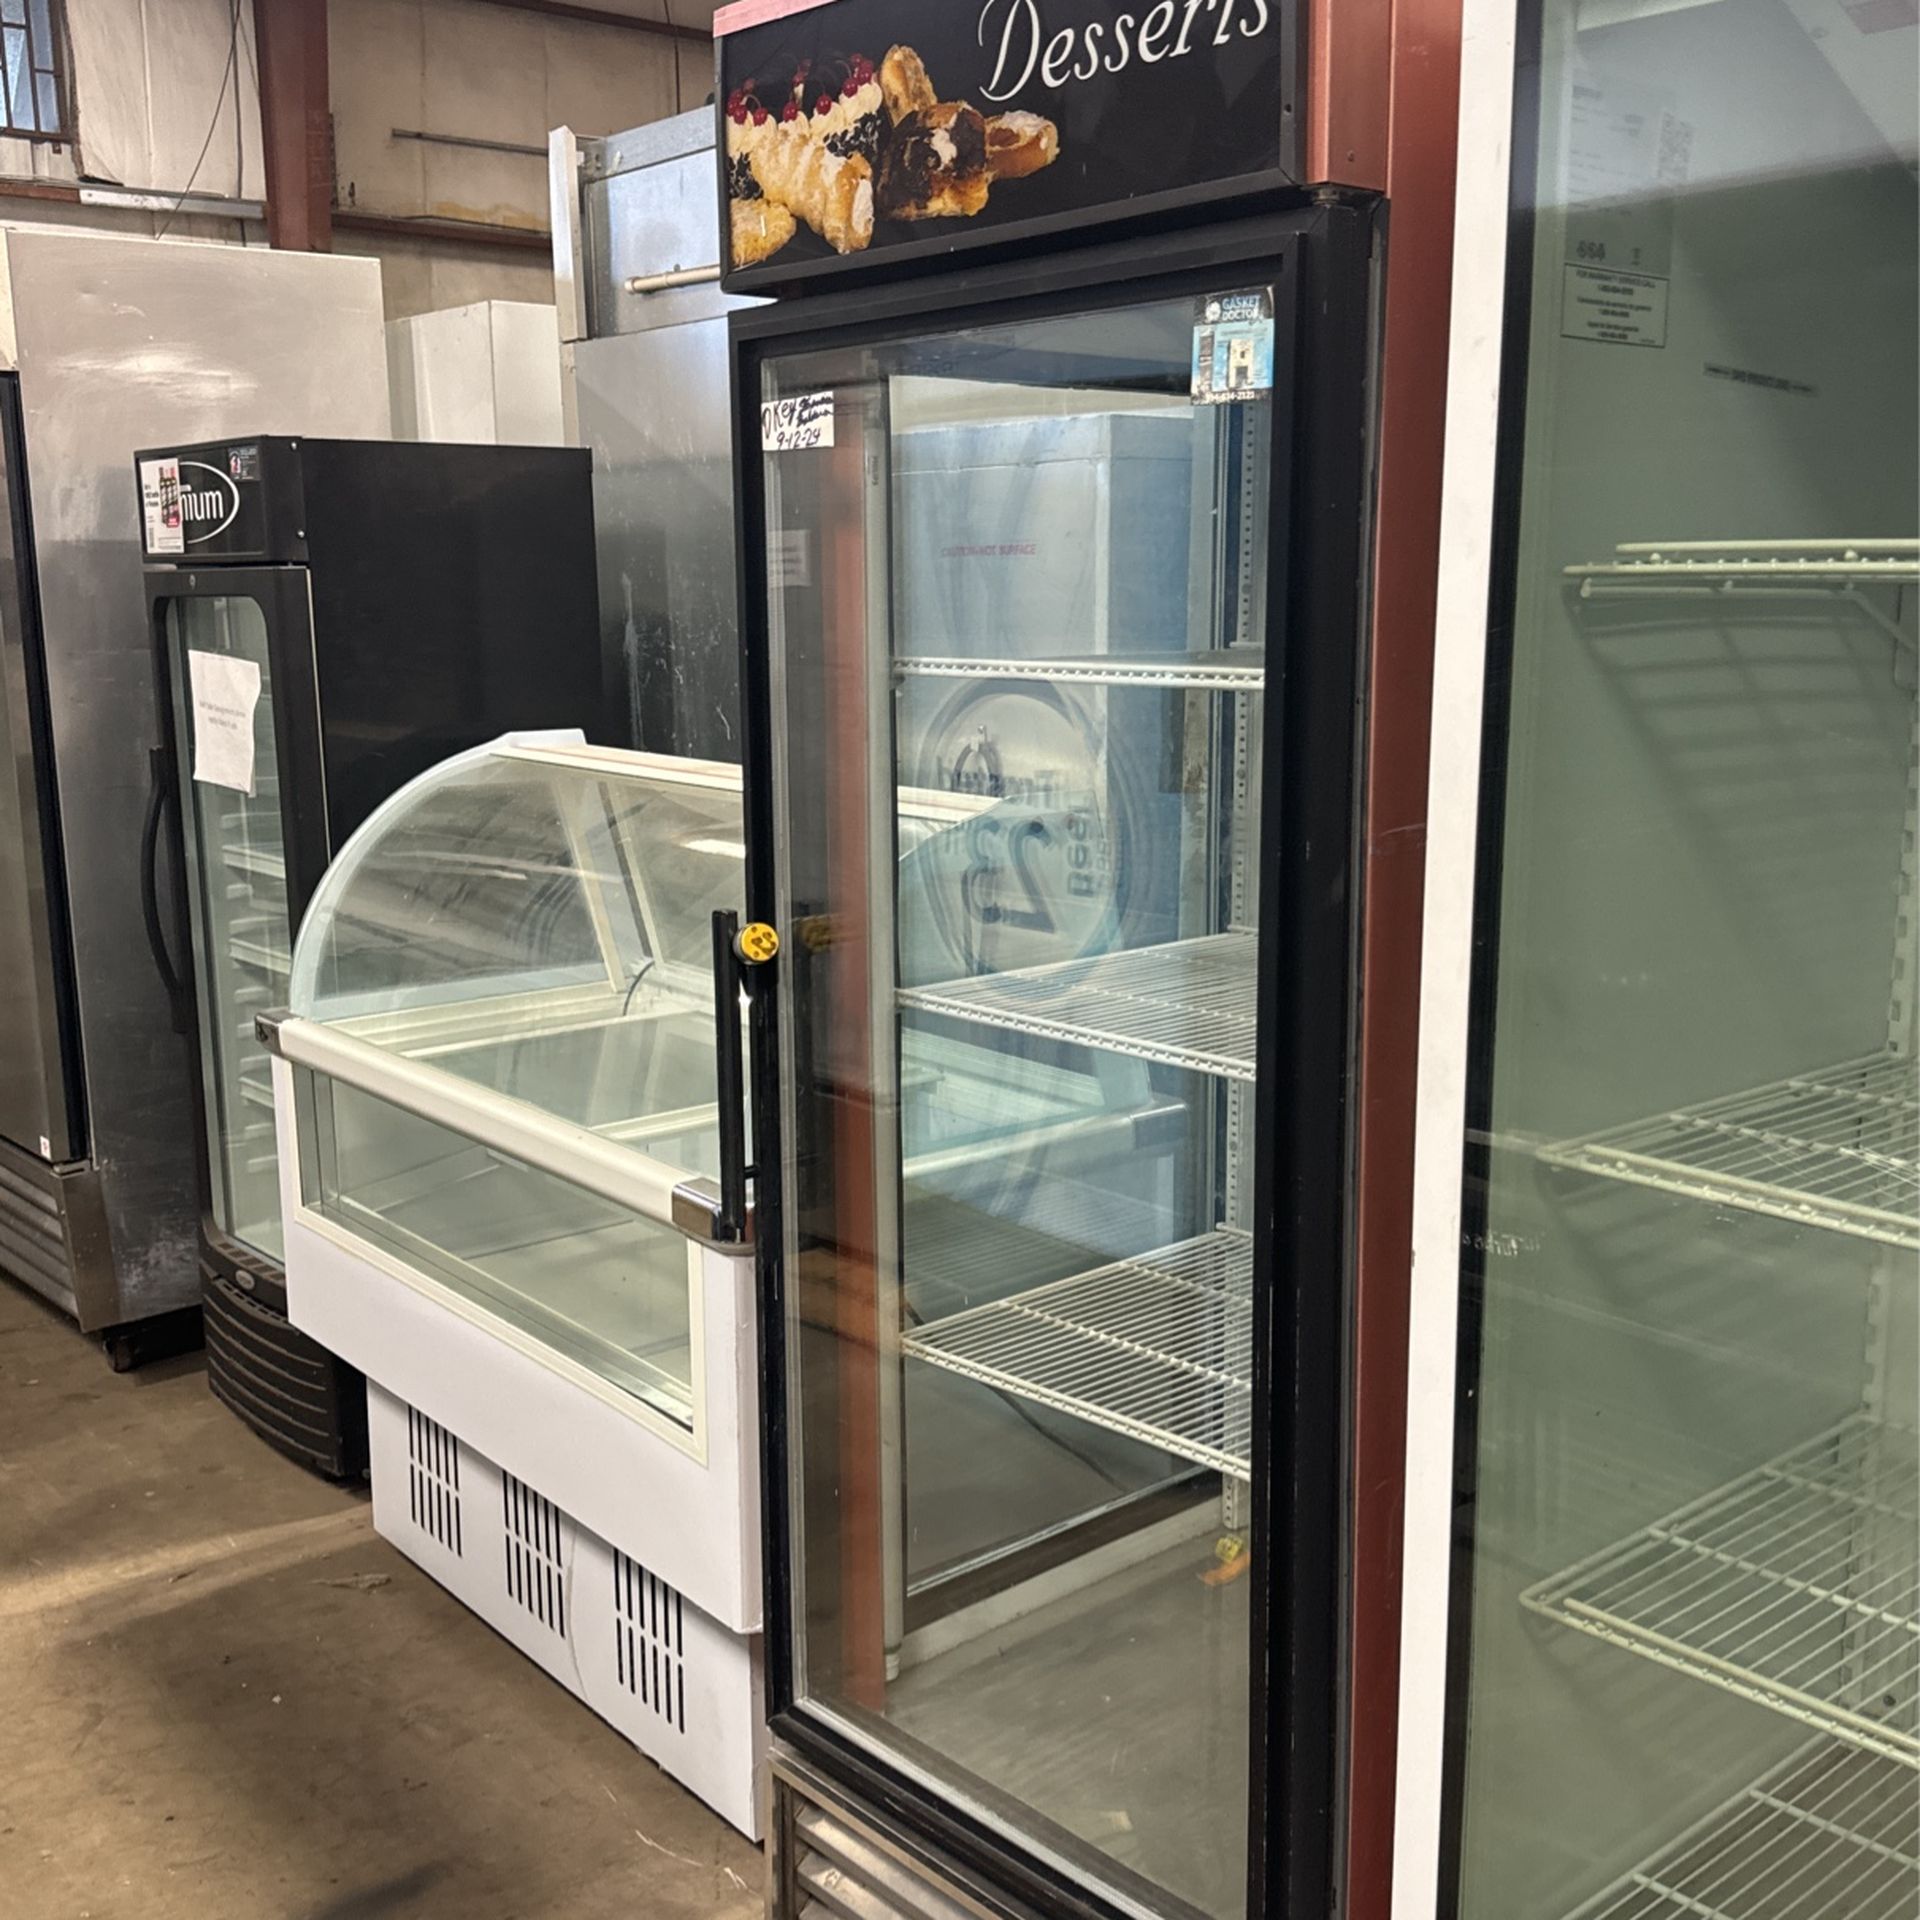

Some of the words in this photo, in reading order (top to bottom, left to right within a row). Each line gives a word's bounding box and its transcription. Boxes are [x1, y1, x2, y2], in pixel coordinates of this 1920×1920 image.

[979, 0, 1268, 101] Desserts
[1222, 296, 1261, 309] GASKET
[777, 428, 821, 451] 9-12-24
